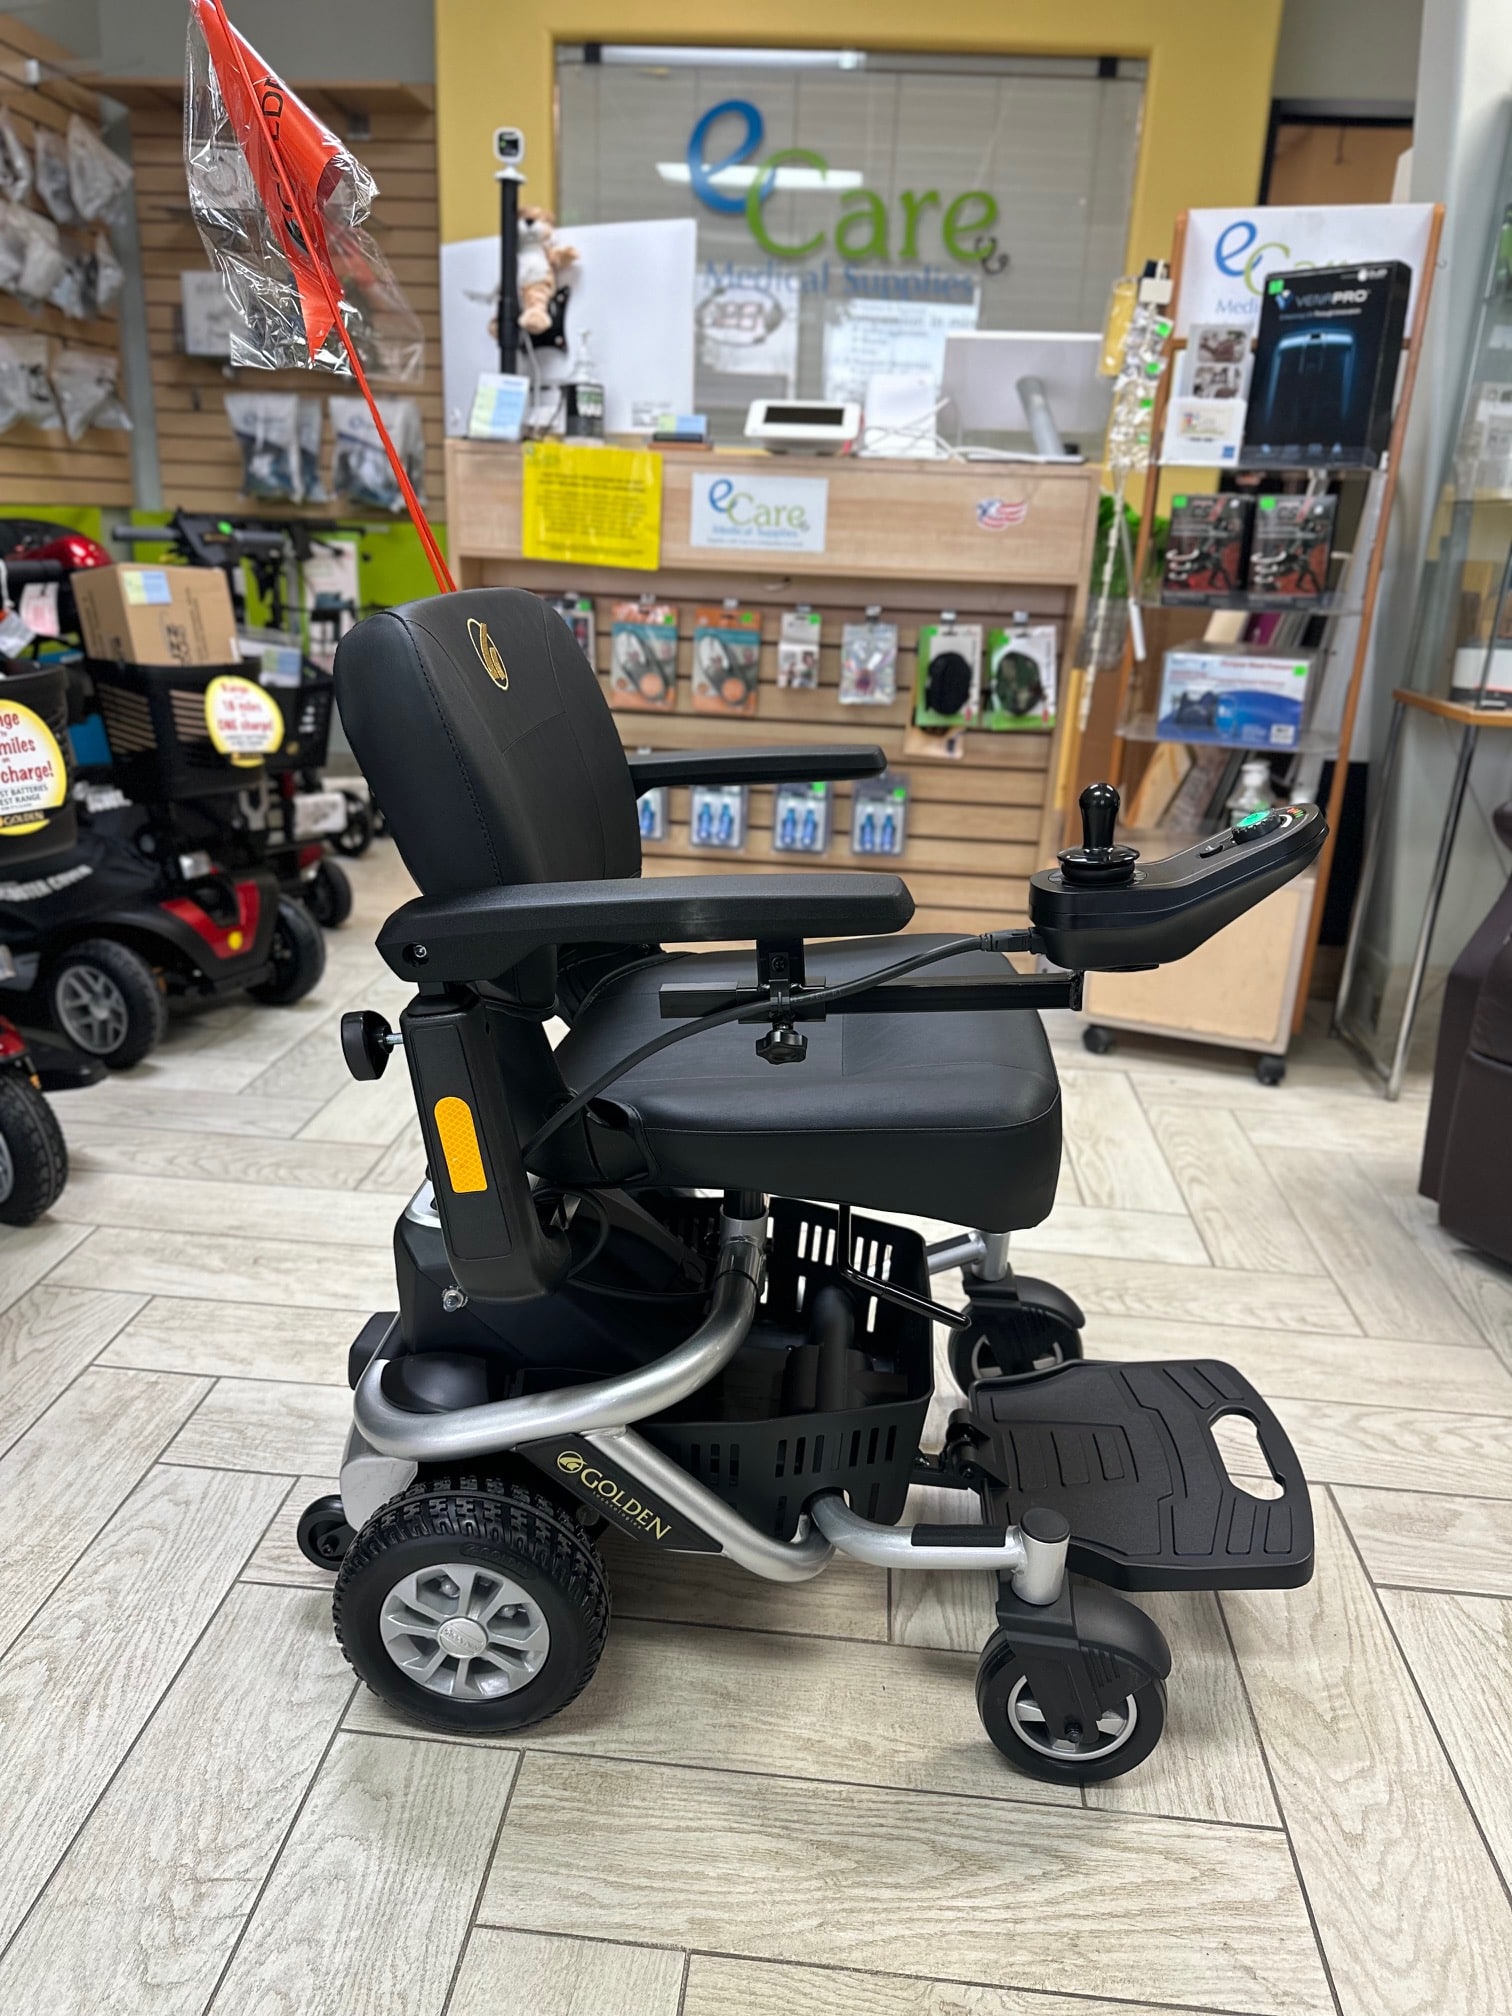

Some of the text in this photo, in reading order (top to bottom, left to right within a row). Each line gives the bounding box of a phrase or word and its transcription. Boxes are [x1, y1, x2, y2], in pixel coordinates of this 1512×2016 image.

[687, 99, 999, 260] eCare
[703, 261, 975, 299] Medical Supplies
[1215, 298, 1260, 315] Medi
[708, 477, 806, 529] eCare
[0, 736, 36, 756] miles
[1, 760, 54, 783] charge!
[580, 1468, 672, 1540] GOLDEN
